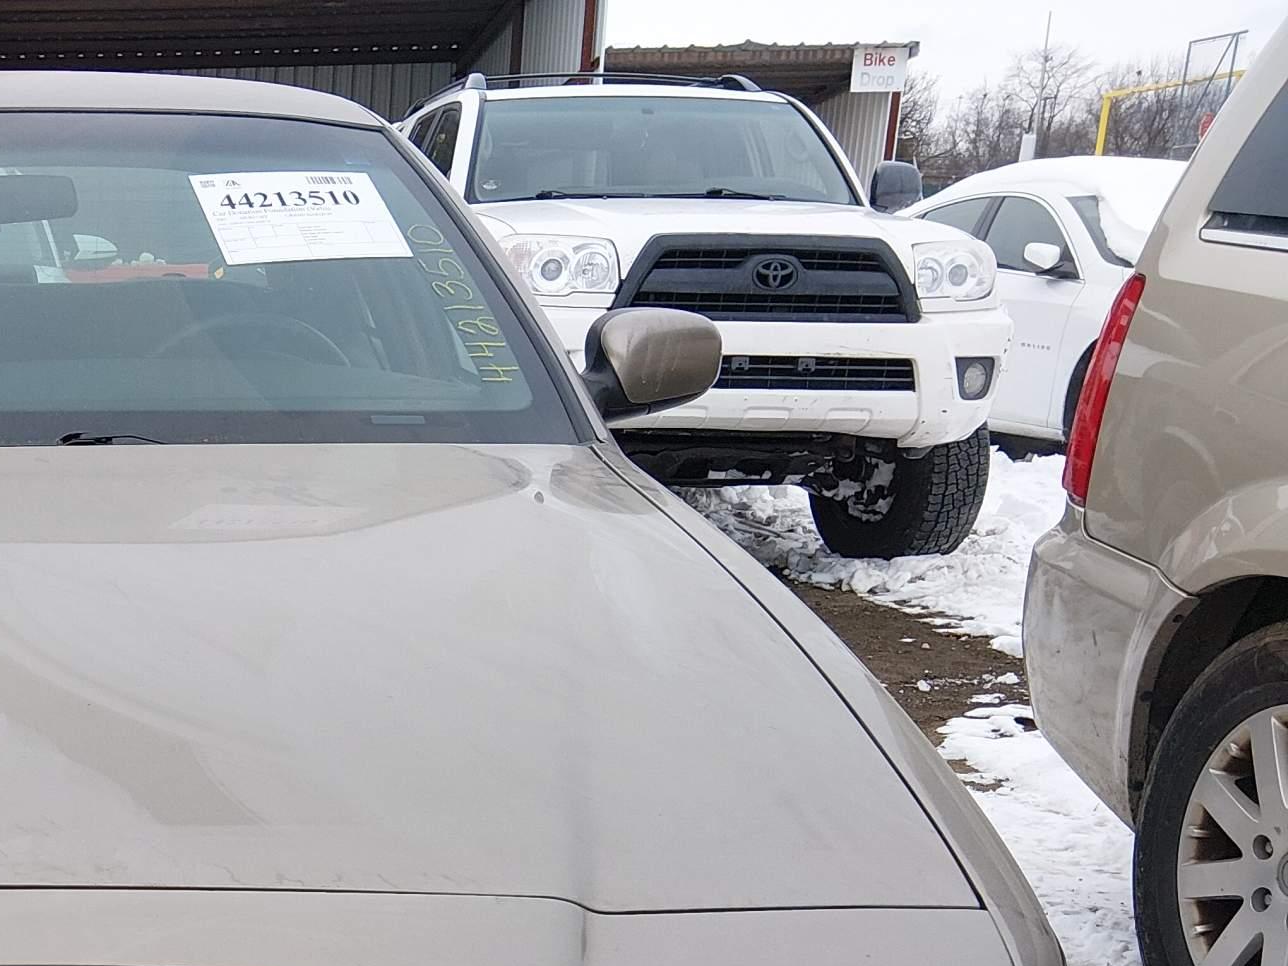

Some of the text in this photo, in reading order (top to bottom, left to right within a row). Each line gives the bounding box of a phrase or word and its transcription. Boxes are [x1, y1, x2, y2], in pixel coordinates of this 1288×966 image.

[864, 52, 896, 67] Bike
[859, 71, 895, 88] Drop
[219, 188, 361, 210] 44213510
[407, 224, 520, 381] 44213510
